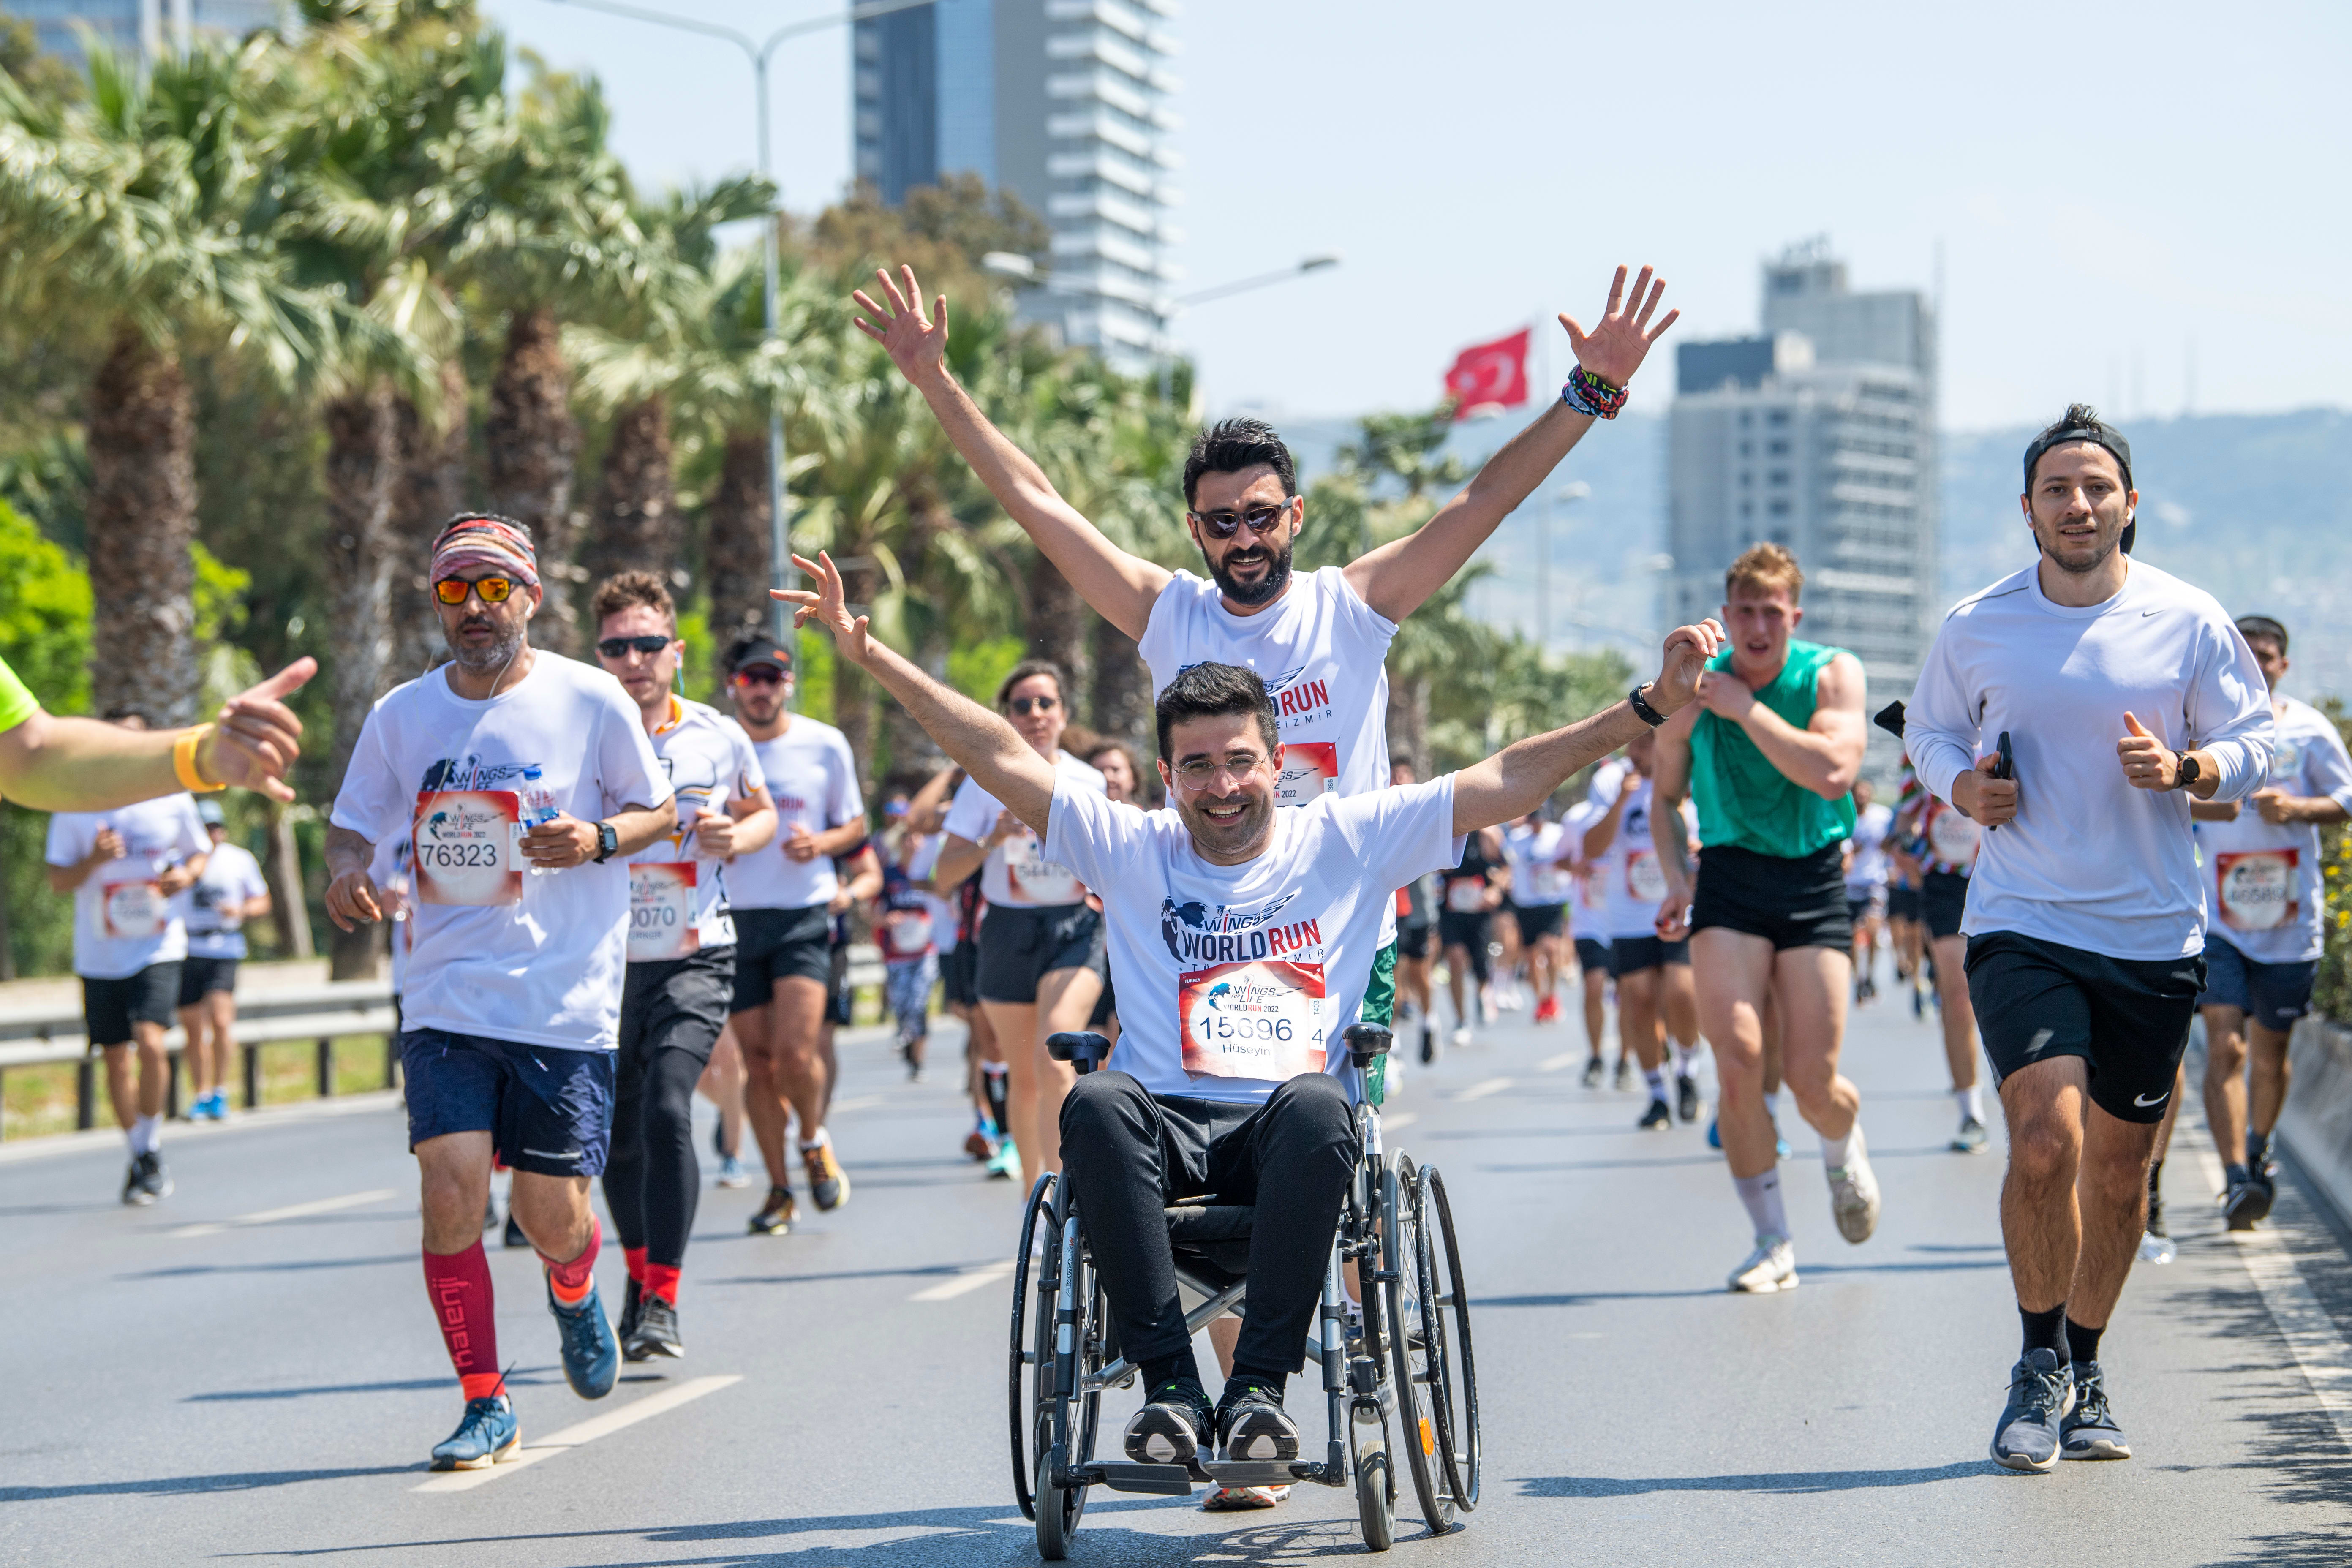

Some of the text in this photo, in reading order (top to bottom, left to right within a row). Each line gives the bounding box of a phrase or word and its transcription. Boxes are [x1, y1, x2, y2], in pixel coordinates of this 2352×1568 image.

[1282, 790, 1297, 798] 2022
[421, 844, 497, 867] 76323
[1200, 1016, 1293, 1041] 15696
[1312, 1029, 1324, 1045] 4
[1223, 1043, 1271, 1056] Hüseyin
